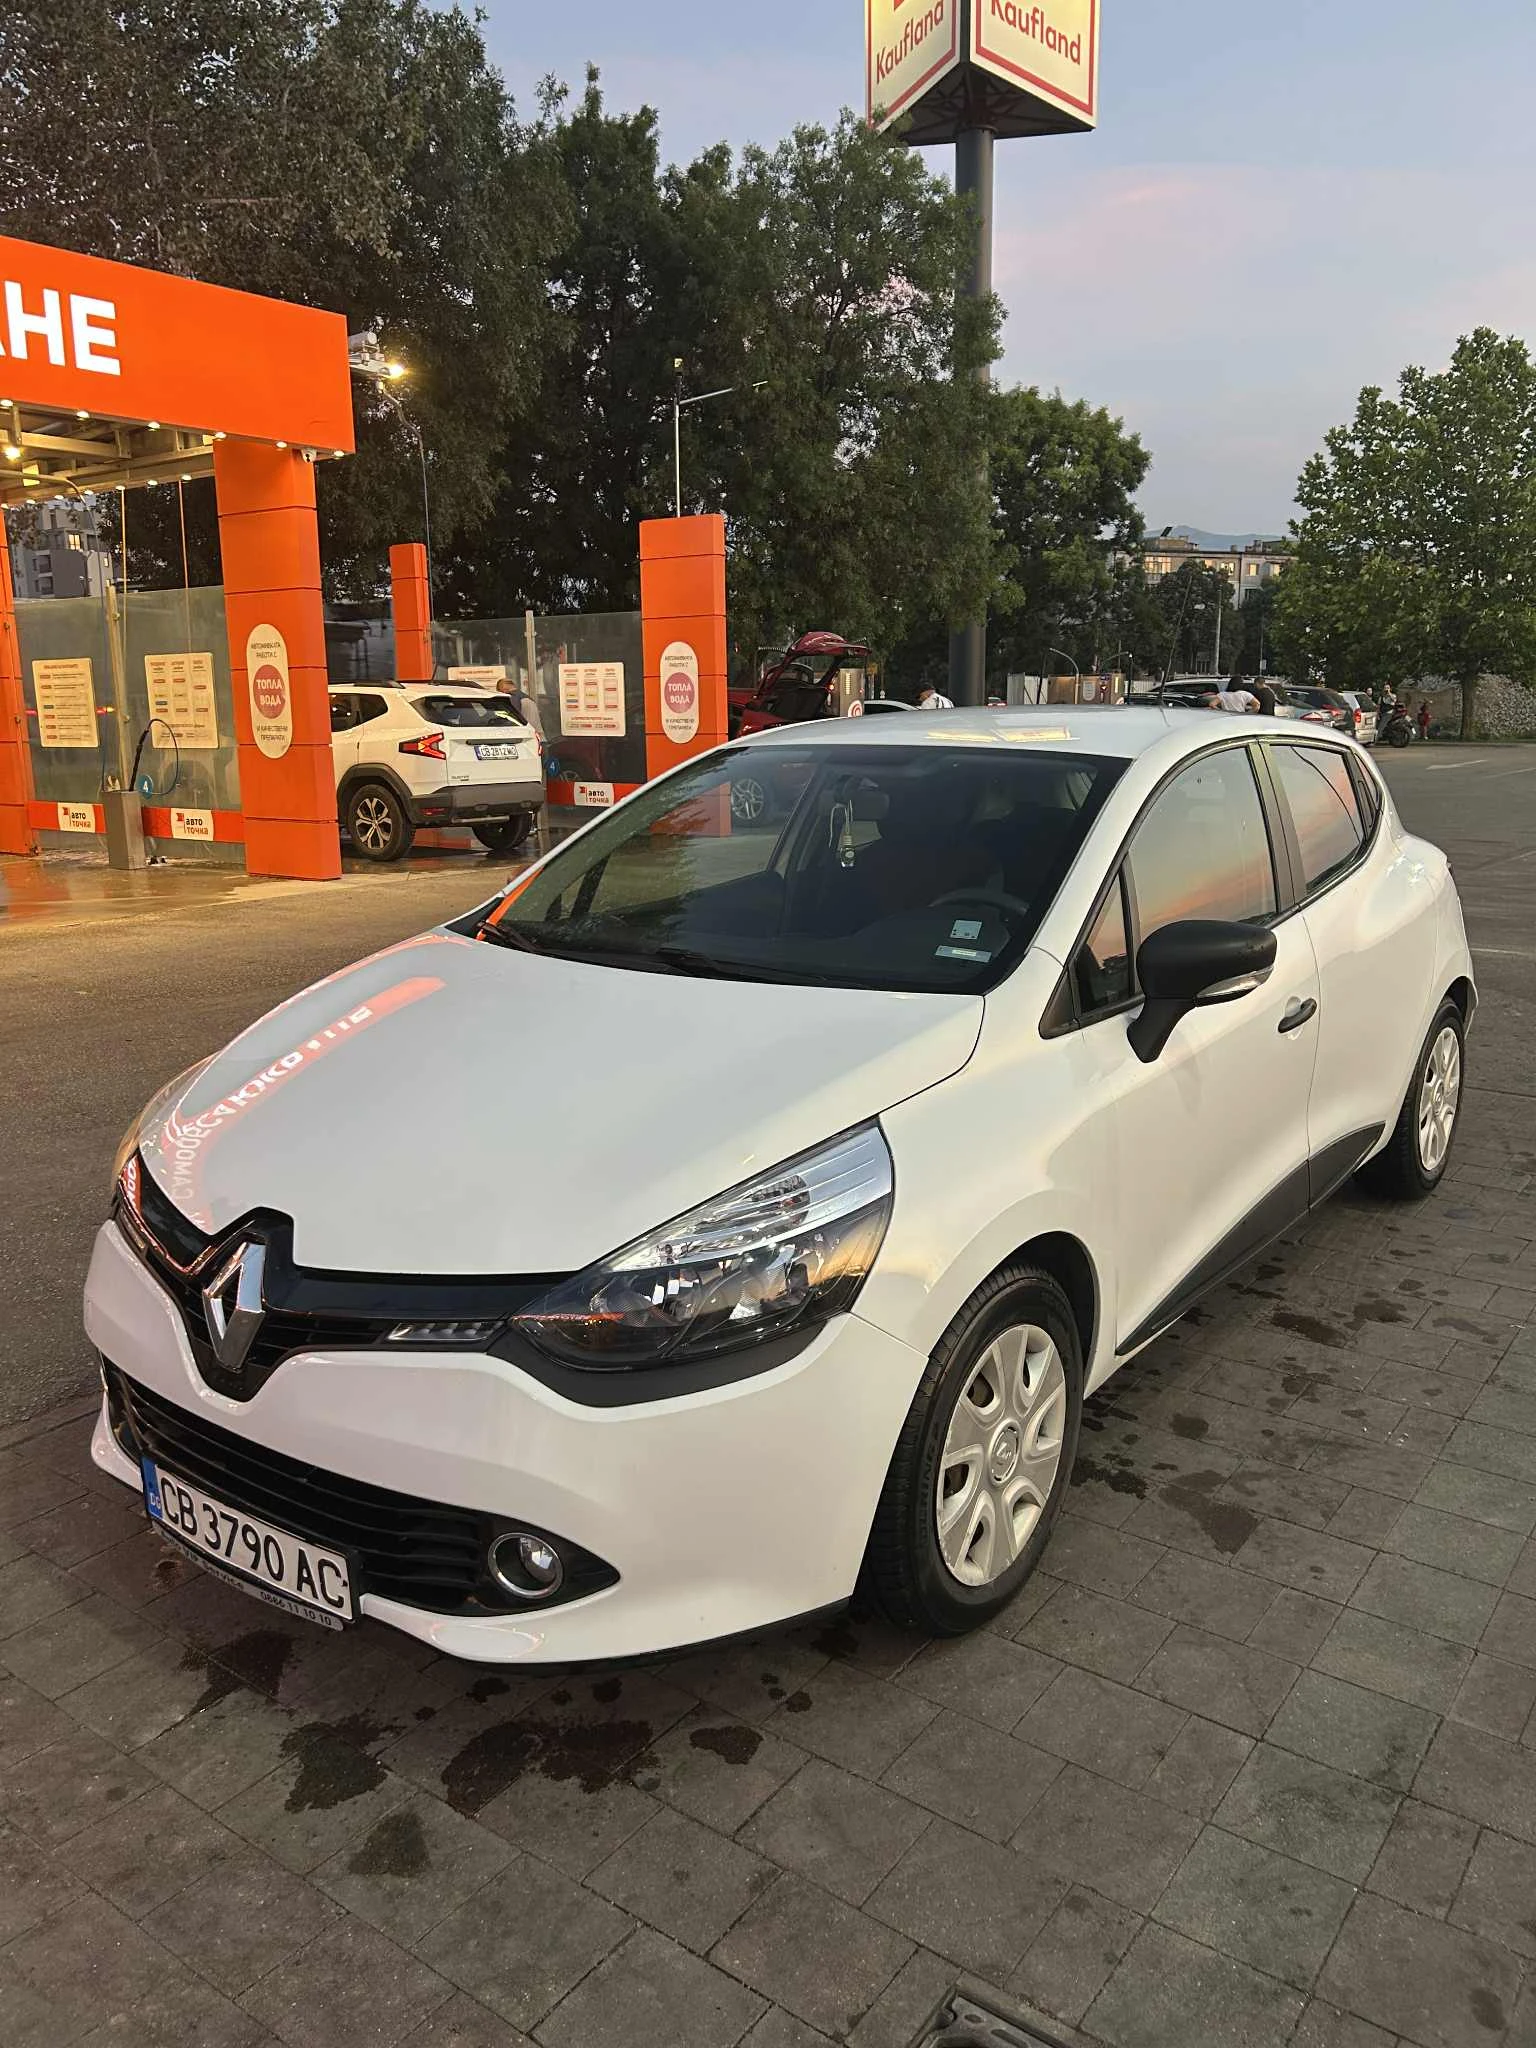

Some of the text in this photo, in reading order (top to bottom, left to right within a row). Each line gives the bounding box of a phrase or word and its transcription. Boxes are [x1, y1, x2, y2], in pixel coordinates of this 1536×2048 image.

[876, 0, 944, 85] Kaufland
[991, 0, 1081, 66] Kaufland
[0, 279, 121, 377] НЕ
[255, 679, 283, 690] ТОПЛА
[259, 694, 282, 707] ВОДА
[667, 682, 693, 692] ТОПЛА
[670, 694, 691, 704] ВОДА
[160, 1475, 199, 1536] CB
[201, 1502, 285, 1582] 3790
[295, 1546, 346, 1610] AC
